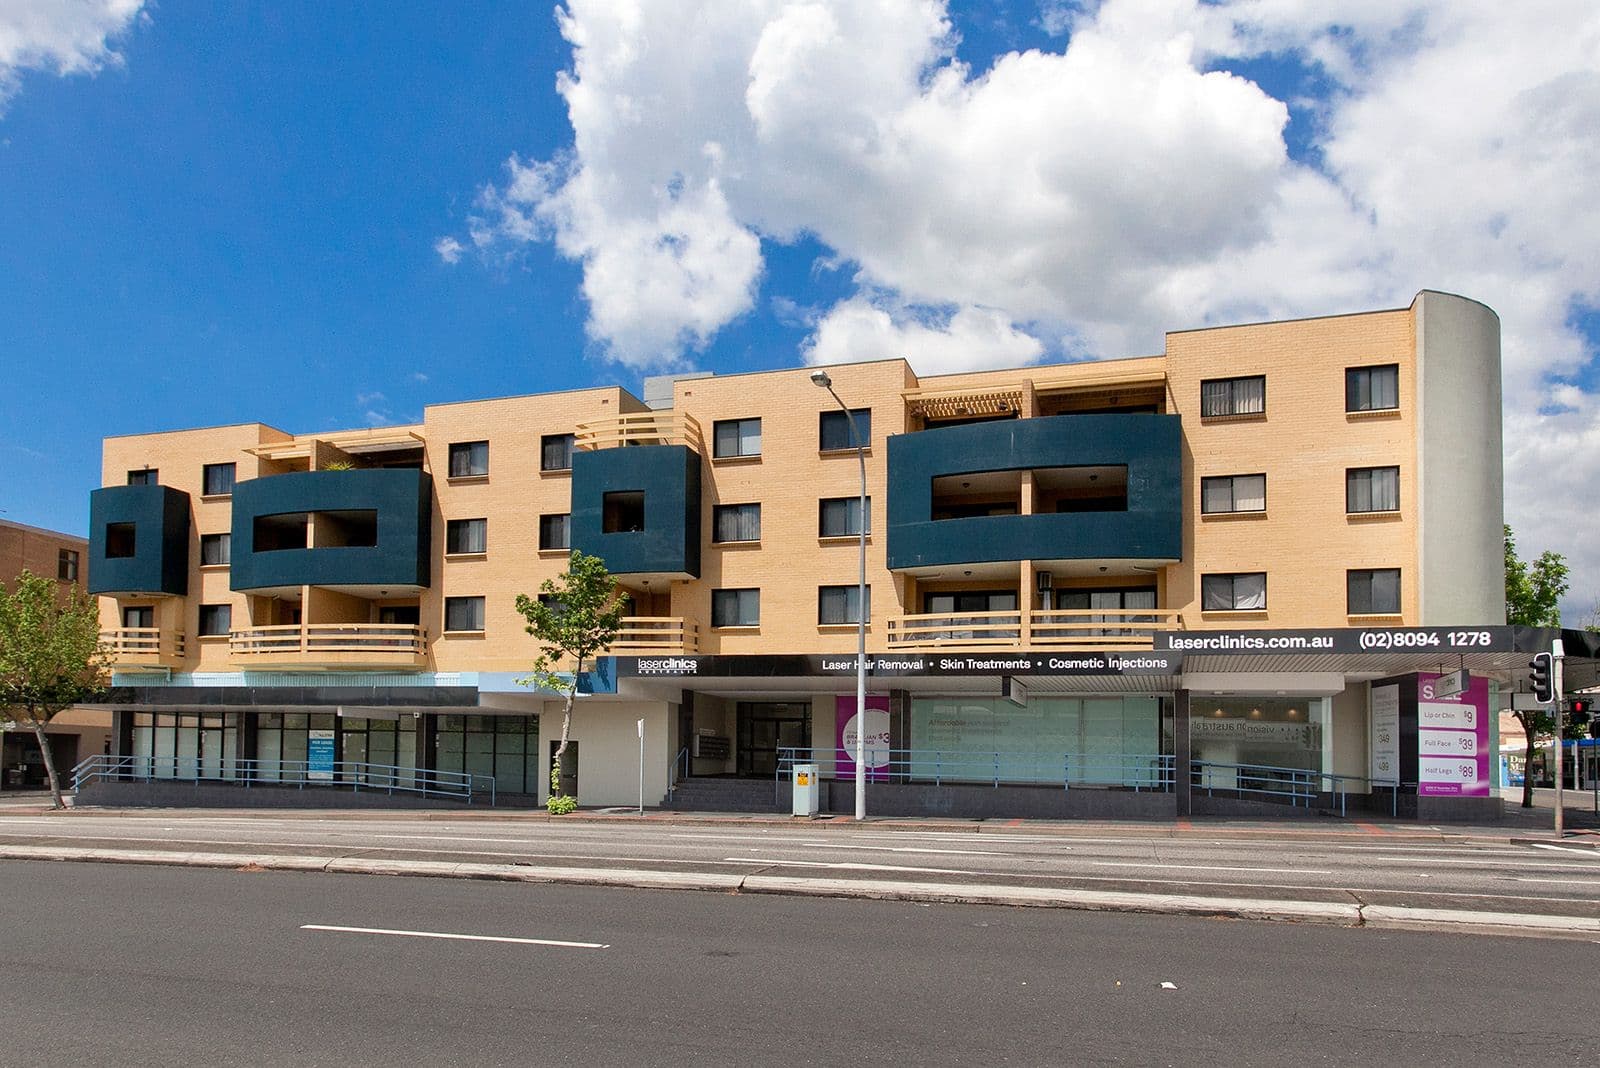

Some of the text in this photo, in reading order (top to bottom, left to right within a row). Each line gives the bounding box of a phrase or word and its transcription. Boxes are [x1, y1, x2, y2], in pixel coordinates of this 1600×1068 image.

[1168, 635, 1333, 649] laserclinics.com.au
[1359, 631, 1491, 649] (02)8094 1278
[638, 658, 698, 669] laserclinics
[822, 660, 851, 670] Laser
[877, 660, 924, 670] Removal
[940, 659, 1031, 669] Skin Treatments
[1049, 658, 1168, 670] Cosmetic Injections
[1464, 710, 1473, 723] $9
[1459, 738, 1473, 750] $39
[1459, 765, 1473, 777] $89
